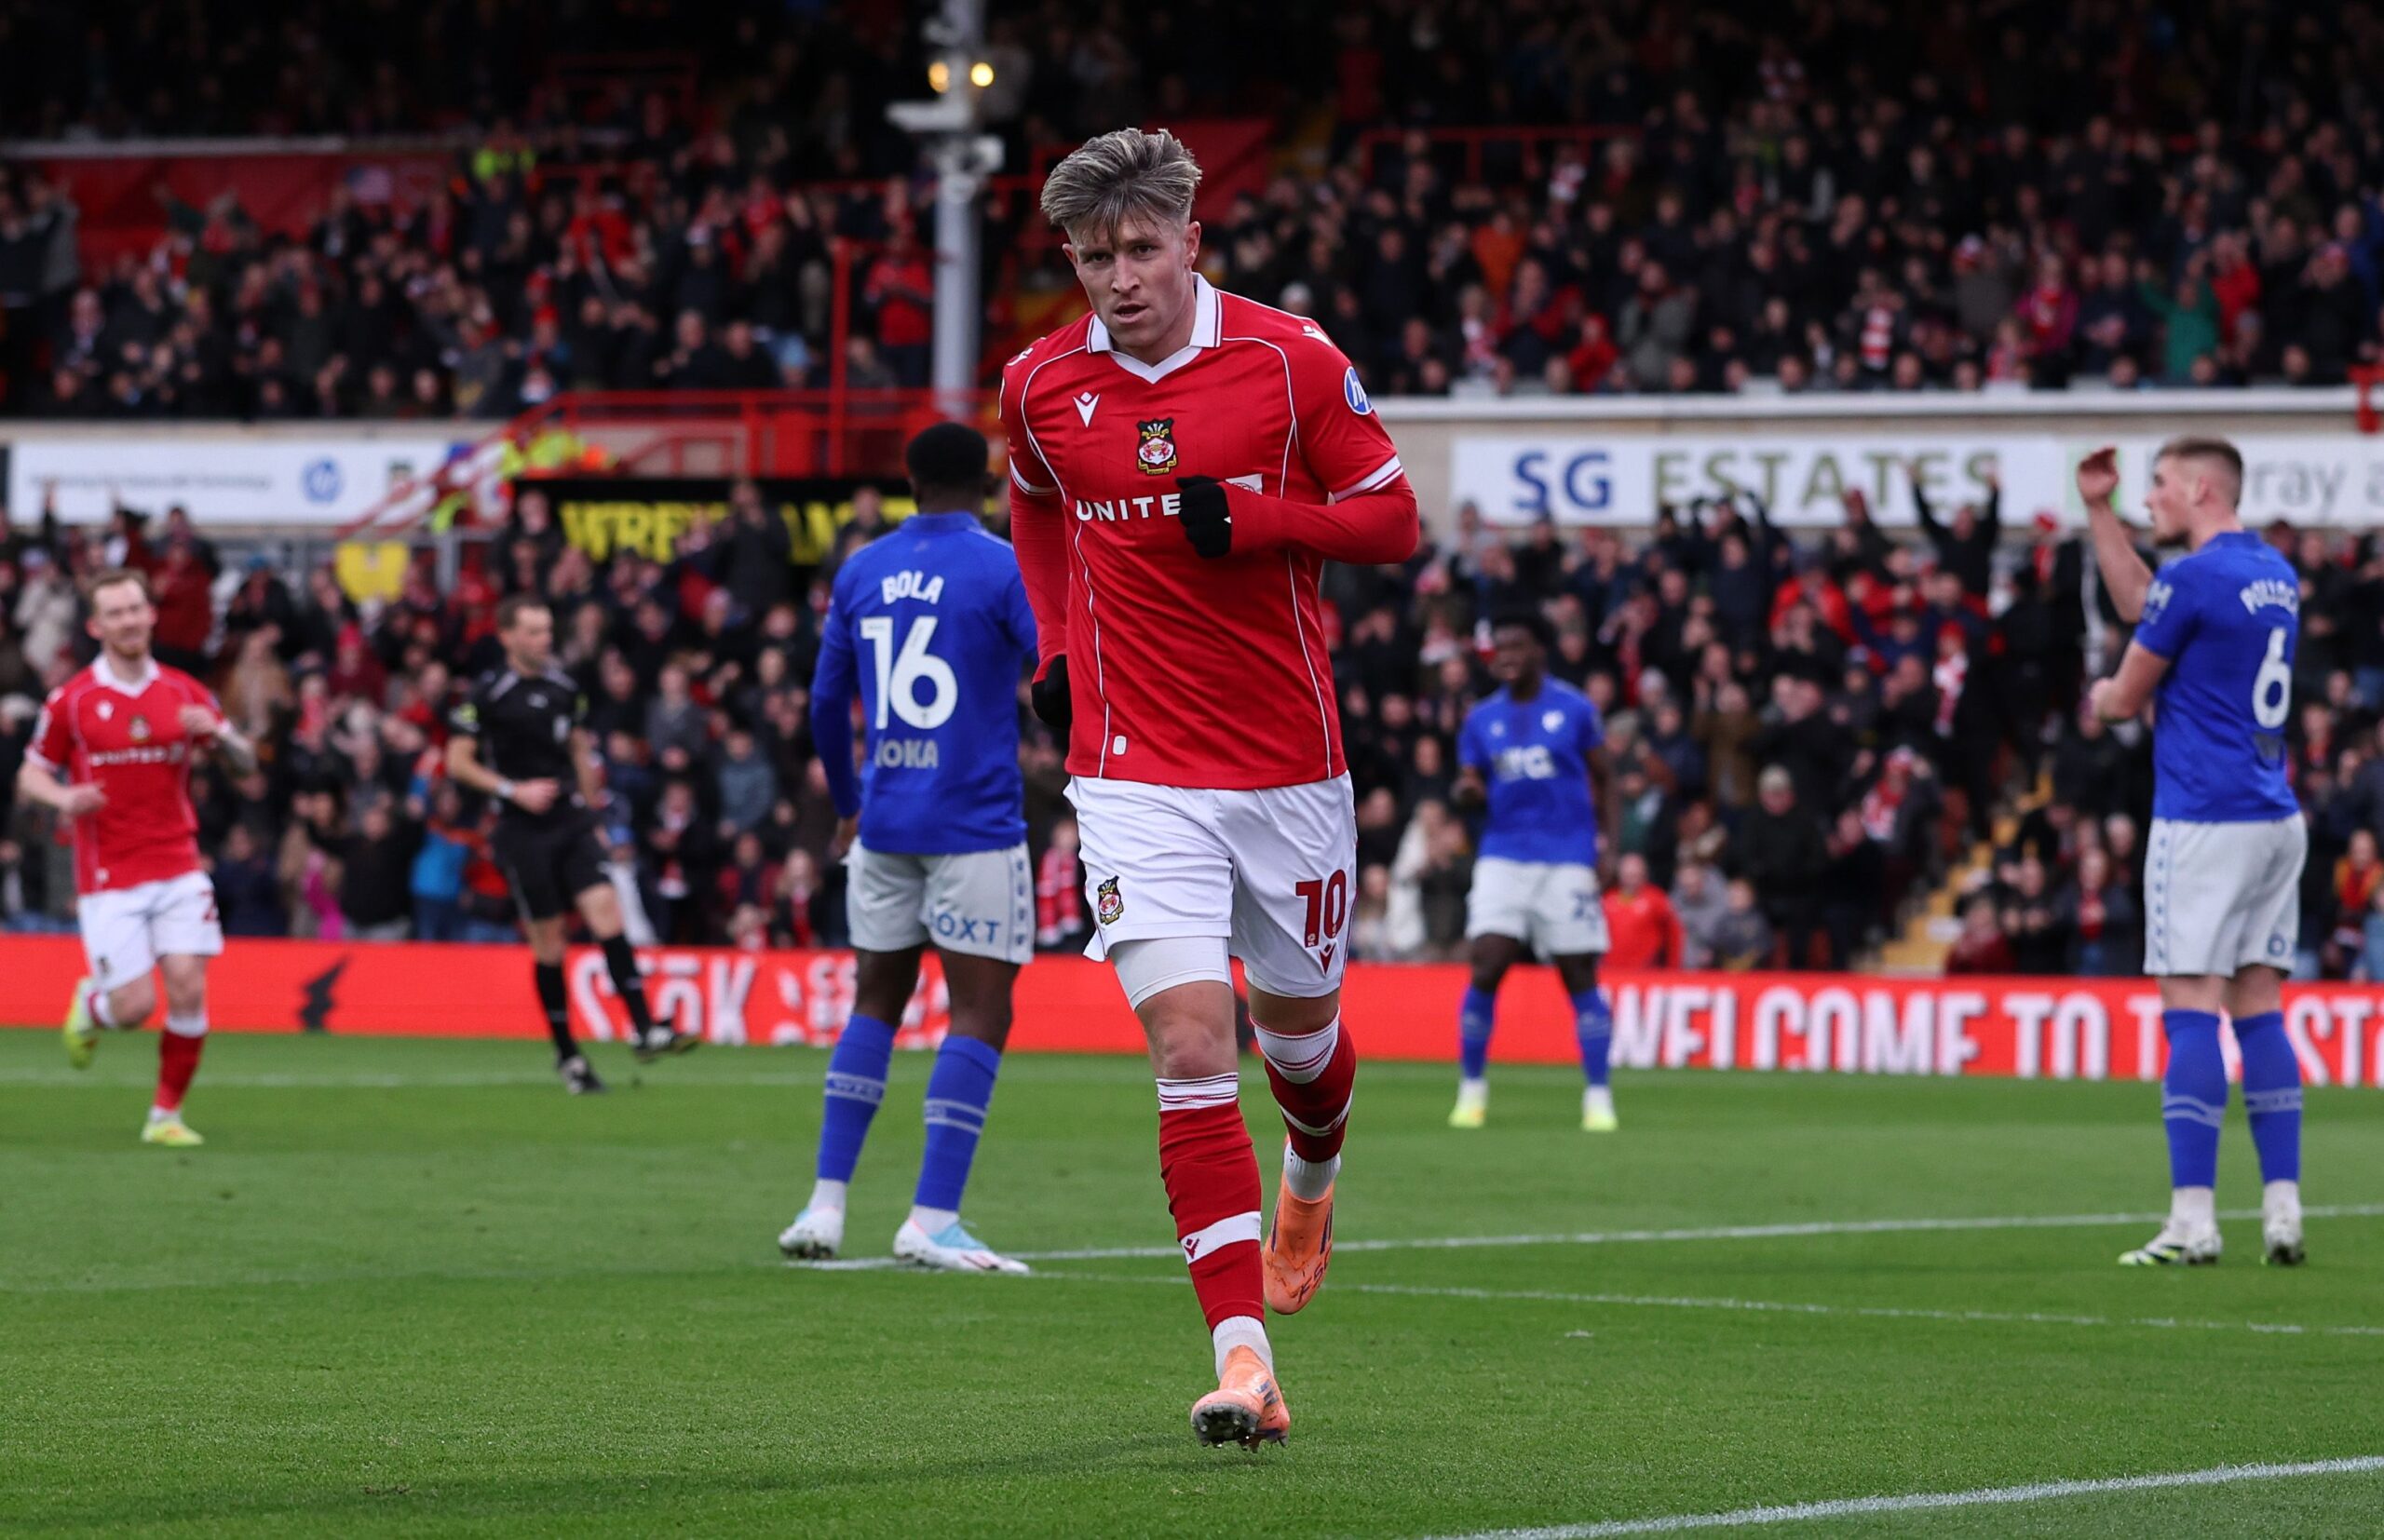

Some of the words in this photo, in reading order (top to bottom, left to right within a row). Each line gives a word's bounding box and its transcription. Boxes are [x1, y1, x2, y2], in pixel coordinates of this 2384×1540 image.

[1076, 493, 1182, 522] UNITE
[1513, 453, 1611, 510] SG
[881, 570, 944, 604] BOLA
[2239, 579, 2299, 620] POLLOC
[860, 615, 958, 730] 16
[2252, 627, 2292, 729] 6
[928, 912, 1000, 944] OXT
[1295, 869, 1347, 949] 10
[1597, 983, 1986, 1077] WELCOME
[2001, 991, 2110, 1082] TO
[2286, 993, 2384, 1088] ST
